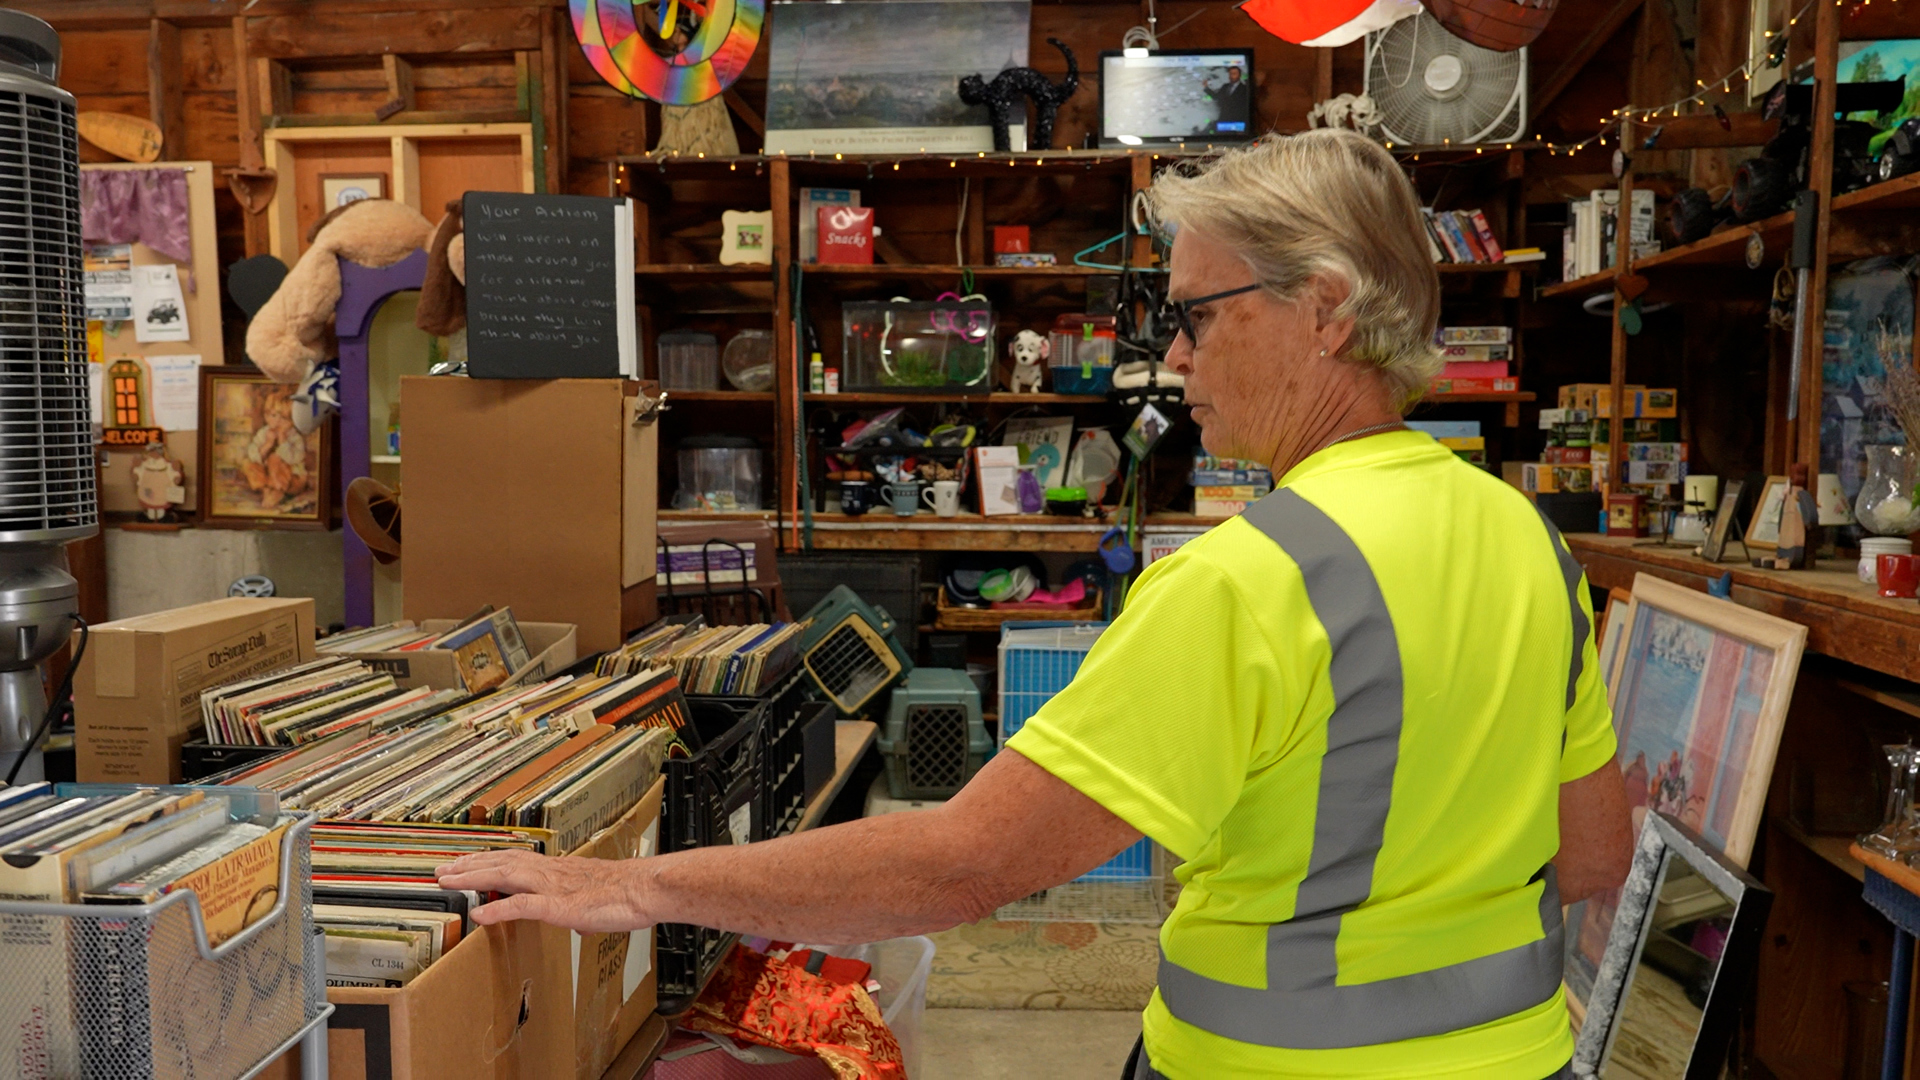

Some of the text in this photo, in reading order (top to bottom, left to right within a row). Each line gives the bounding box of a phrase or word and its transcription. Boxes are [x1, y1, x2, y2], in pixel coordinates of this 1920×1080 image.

[480, 204, 520, 219] Your
[825, 231, 867, 248] Snacks
[524, 255, 578, 267] around
[103, 430, 159, 444] WELCOME
[1151, 536, 1190, 546] AMERIC
[560, 790, 590, 818] STEREO
[371, 957, 404, 970] CL 1344
